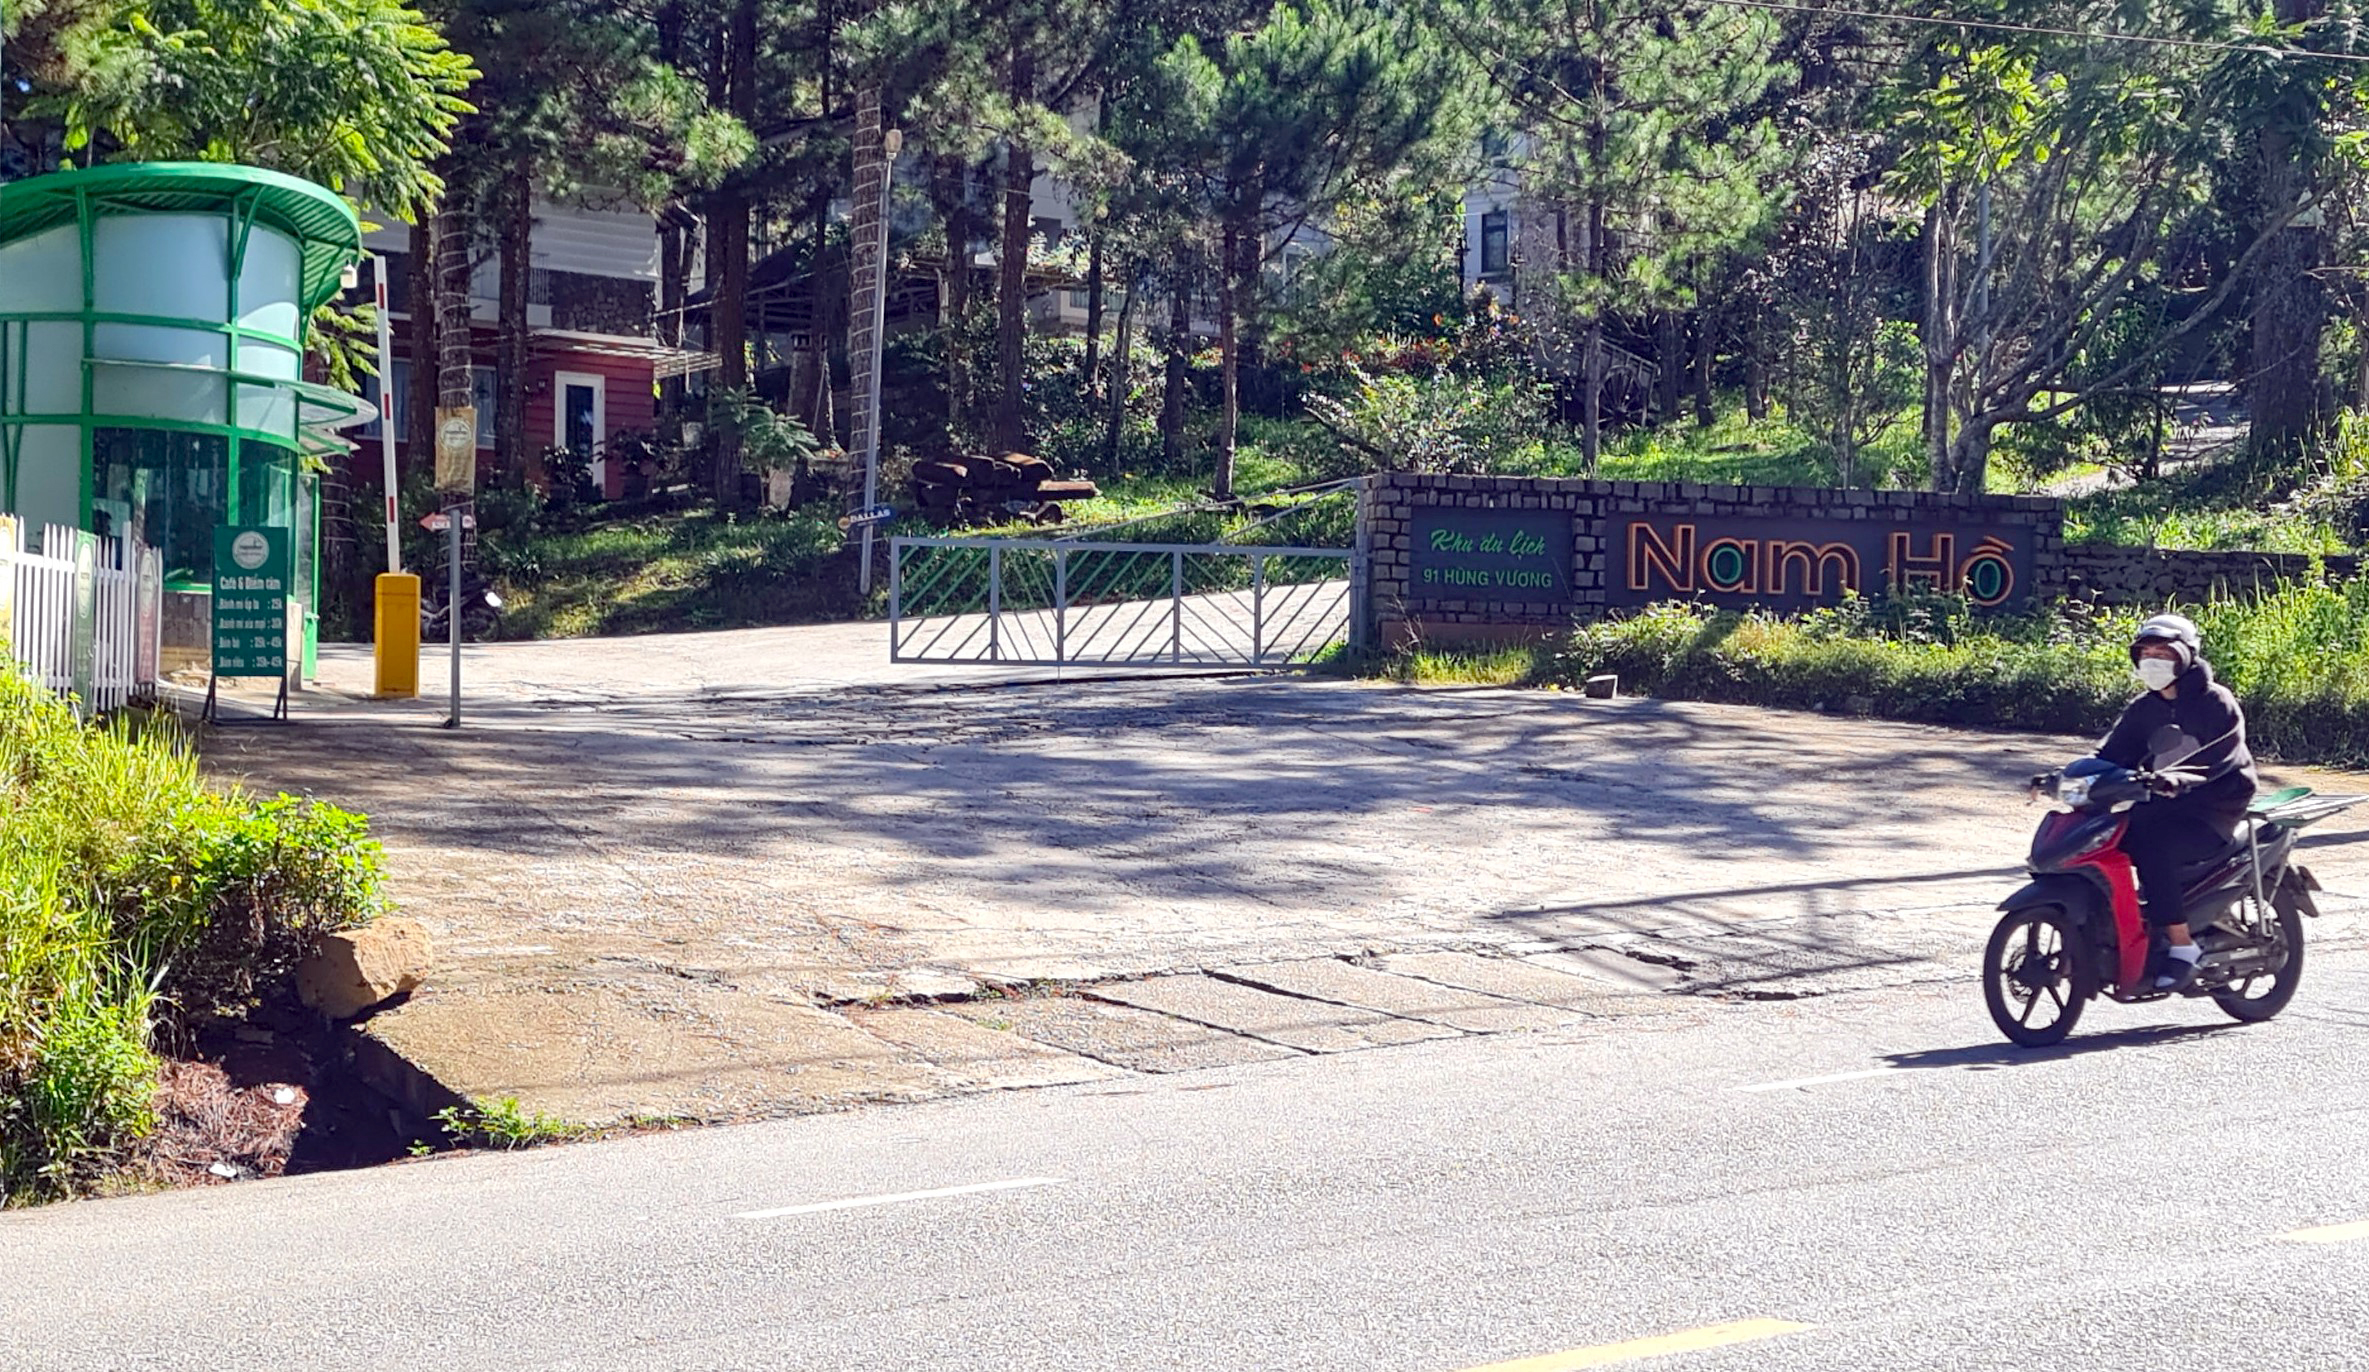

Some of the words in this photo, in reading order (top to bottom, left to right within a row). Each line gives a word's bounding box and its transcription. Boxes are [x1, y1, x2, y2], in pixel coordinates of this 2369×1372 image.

[1431, 529, 1473, 553] Khu
[1479, 532, 1503, 553] du
[1627, 521, 1861, 596] Nam
[1887, 532, 2014, 606] Hồ
[1423, 568, 1439, 583] 91
[1444, 566, 1489, 586] HÙNG
